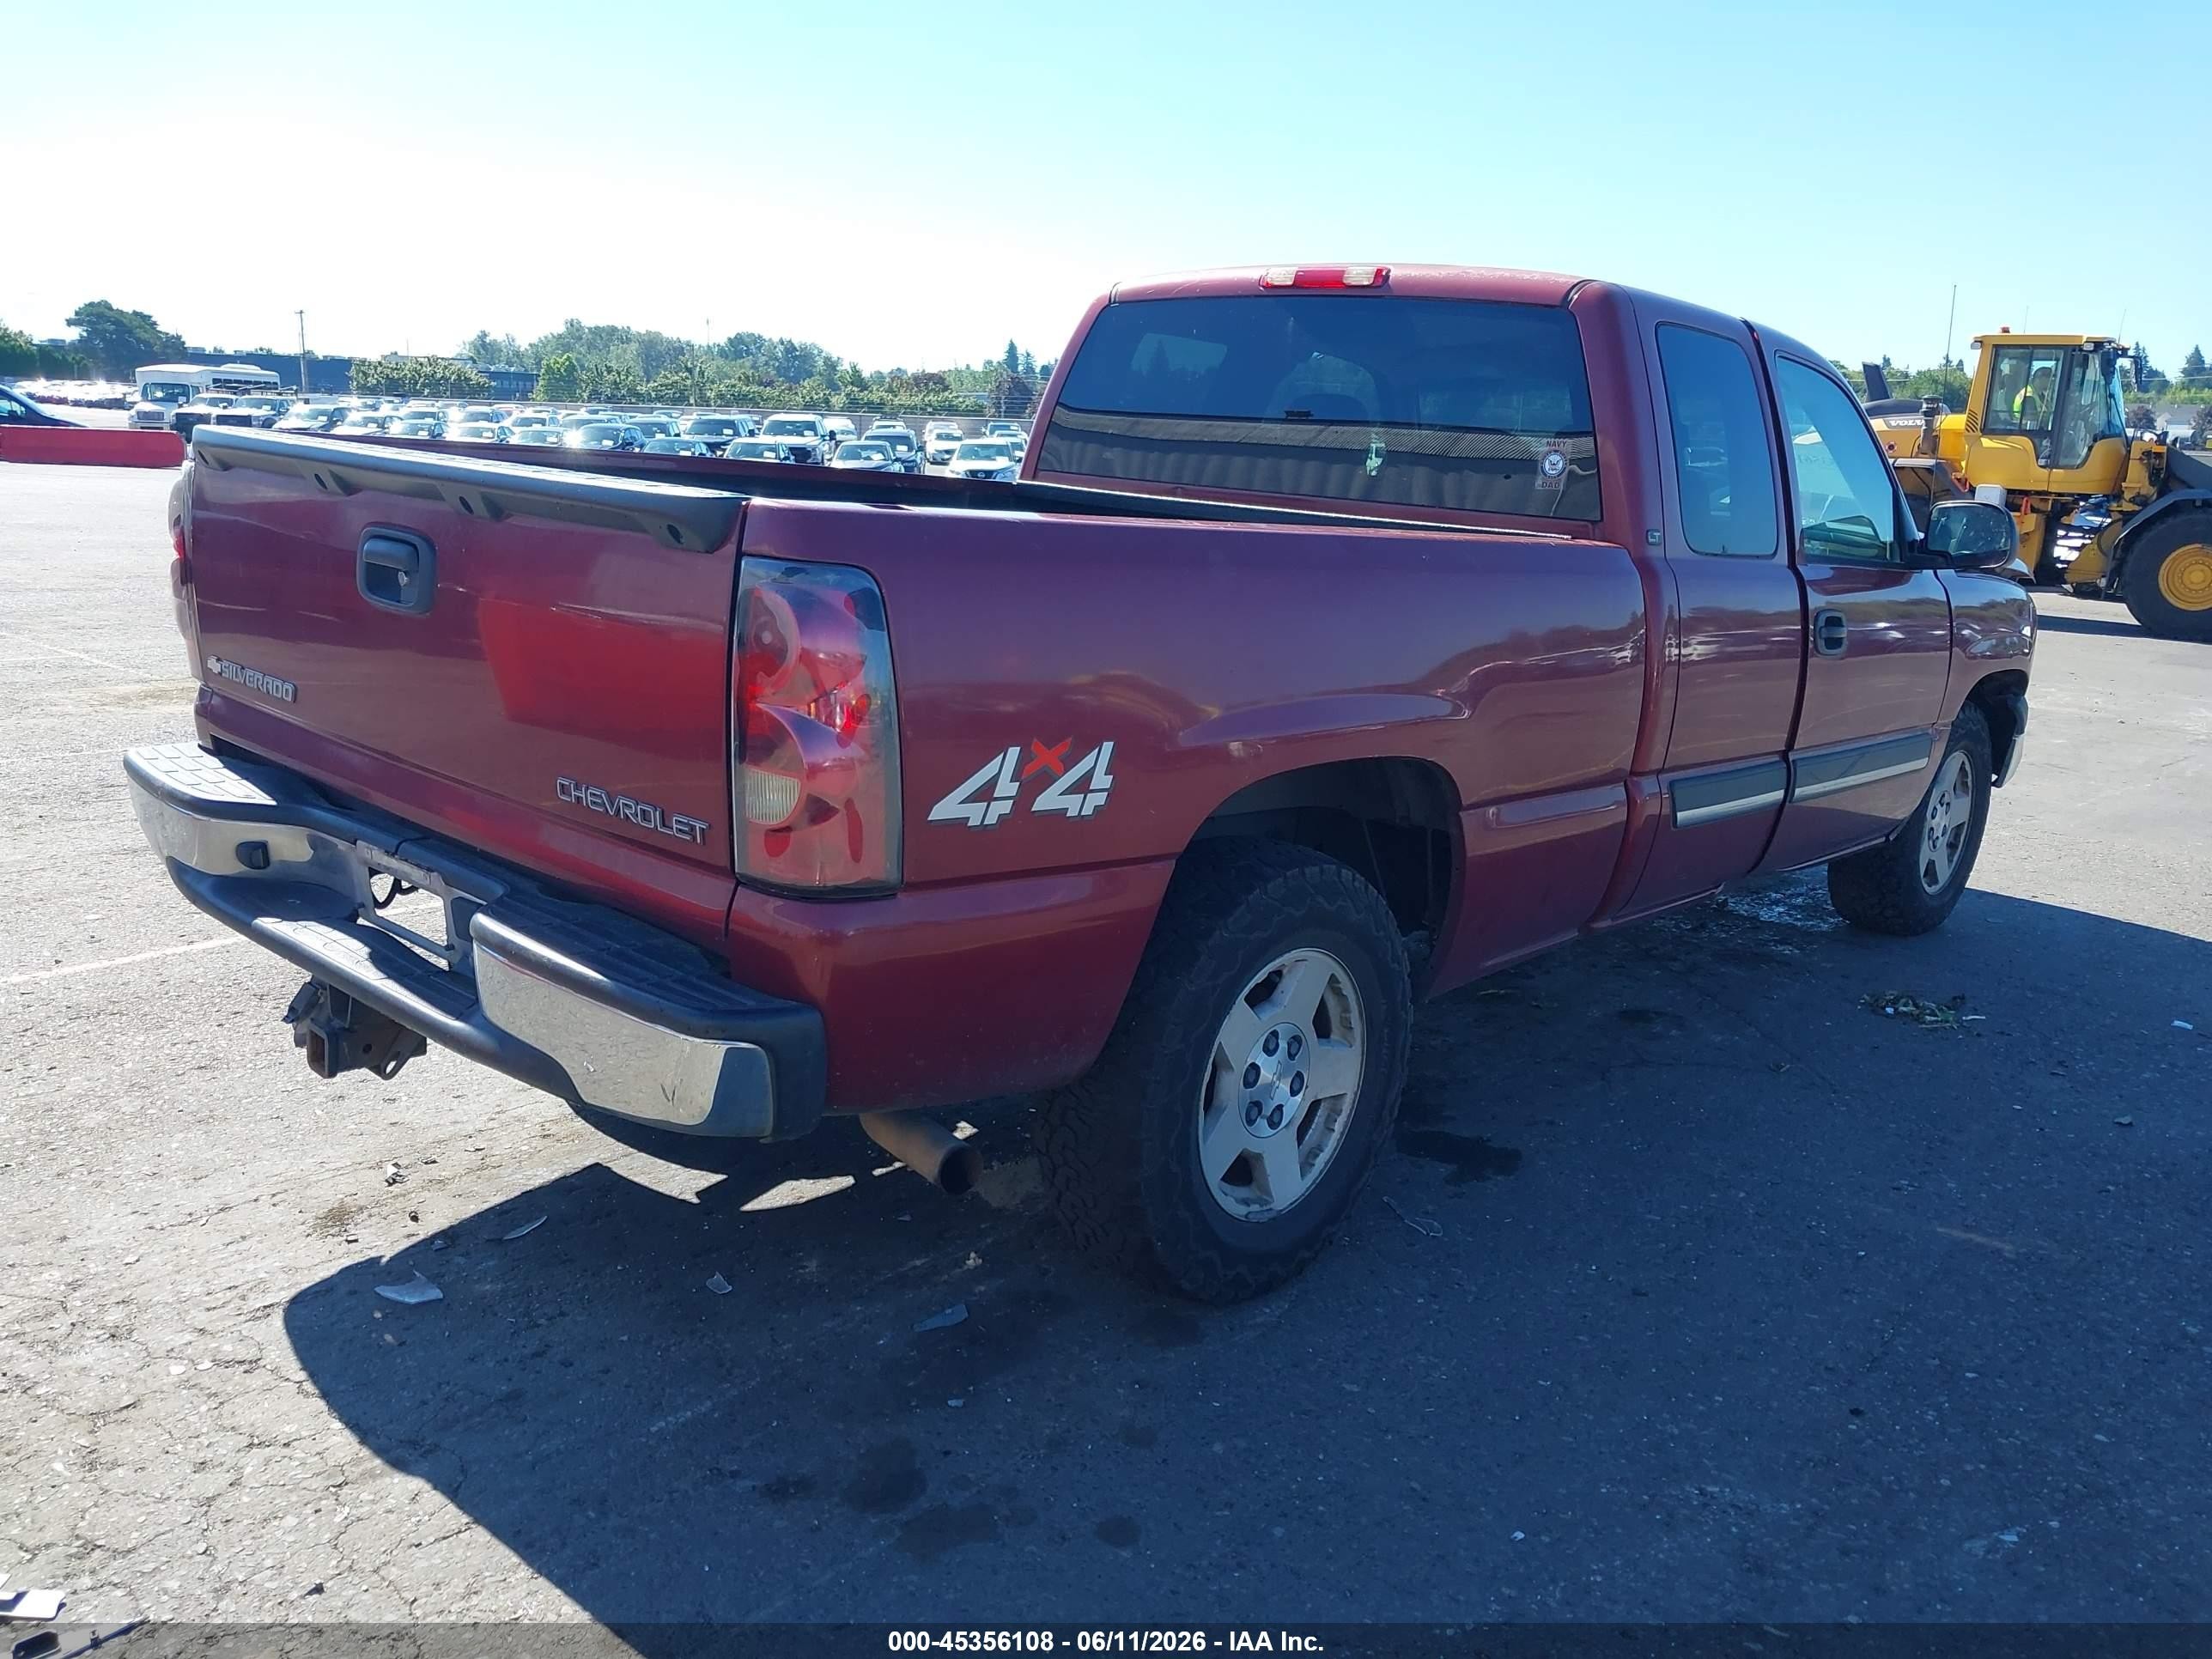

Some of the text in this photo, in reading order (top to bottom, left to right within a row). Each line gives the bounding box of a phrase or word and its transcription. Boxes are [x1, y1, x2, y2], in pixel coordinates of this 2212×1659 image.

[1546, 439, 1567, 447] NAVY
[222, 659, 295, 702] SILVERADO
[556, 776, 710, 845] CHEVROLET
